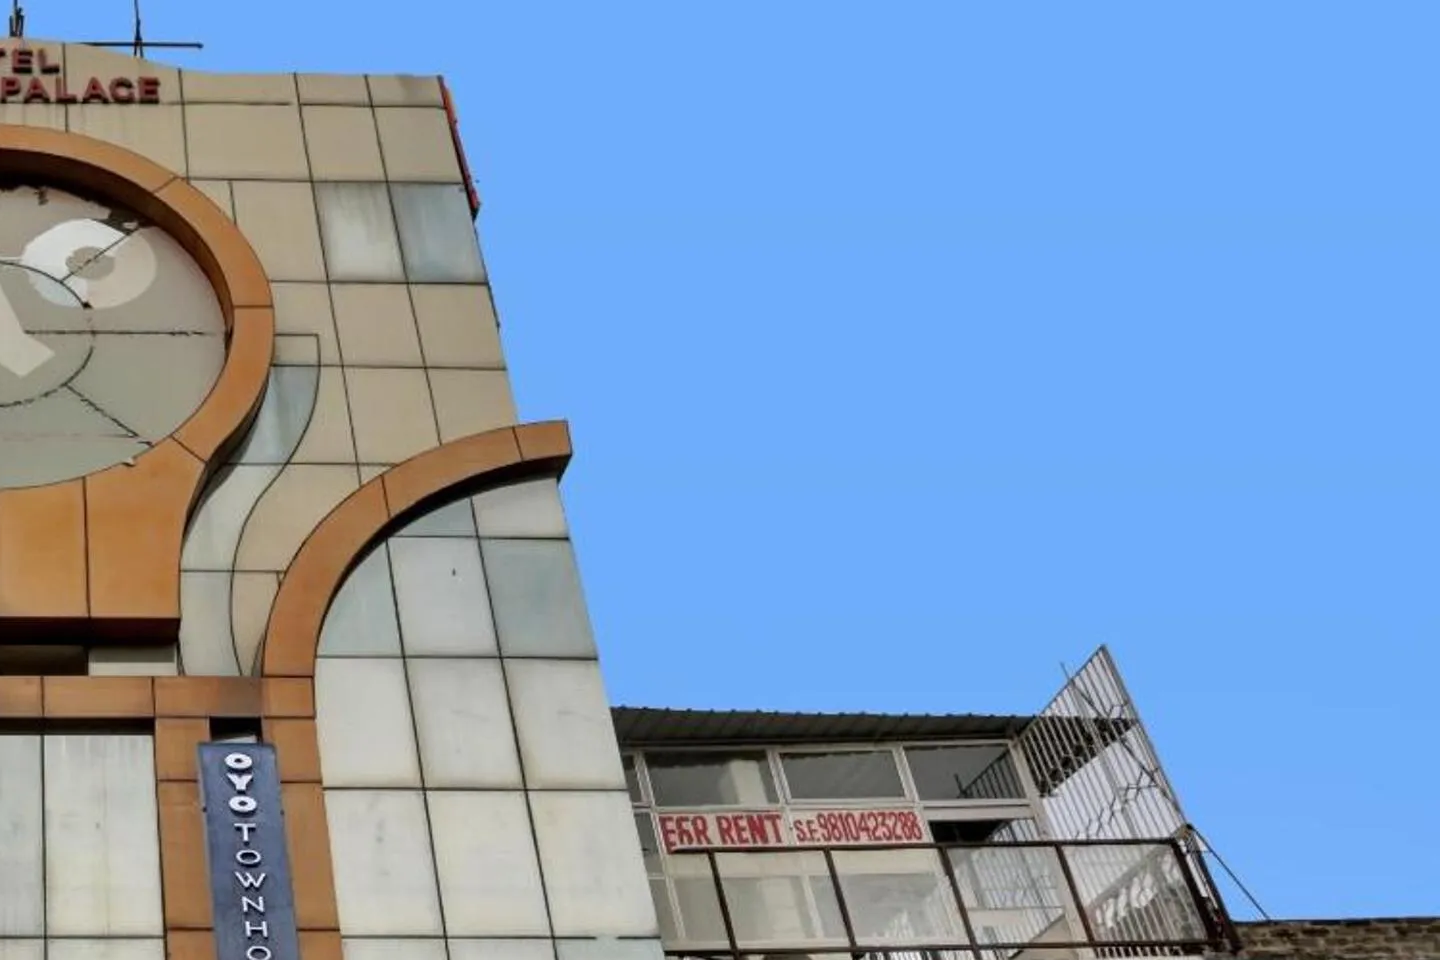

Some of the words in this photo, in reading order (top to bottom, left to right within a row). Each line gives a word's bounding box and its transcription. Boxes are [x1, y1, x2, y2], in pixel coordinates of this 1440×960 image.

[0, 76, 162, 104] PALACE
[224, 752, 259, 814] OYO
[715, 814, 782, 844] RENT
